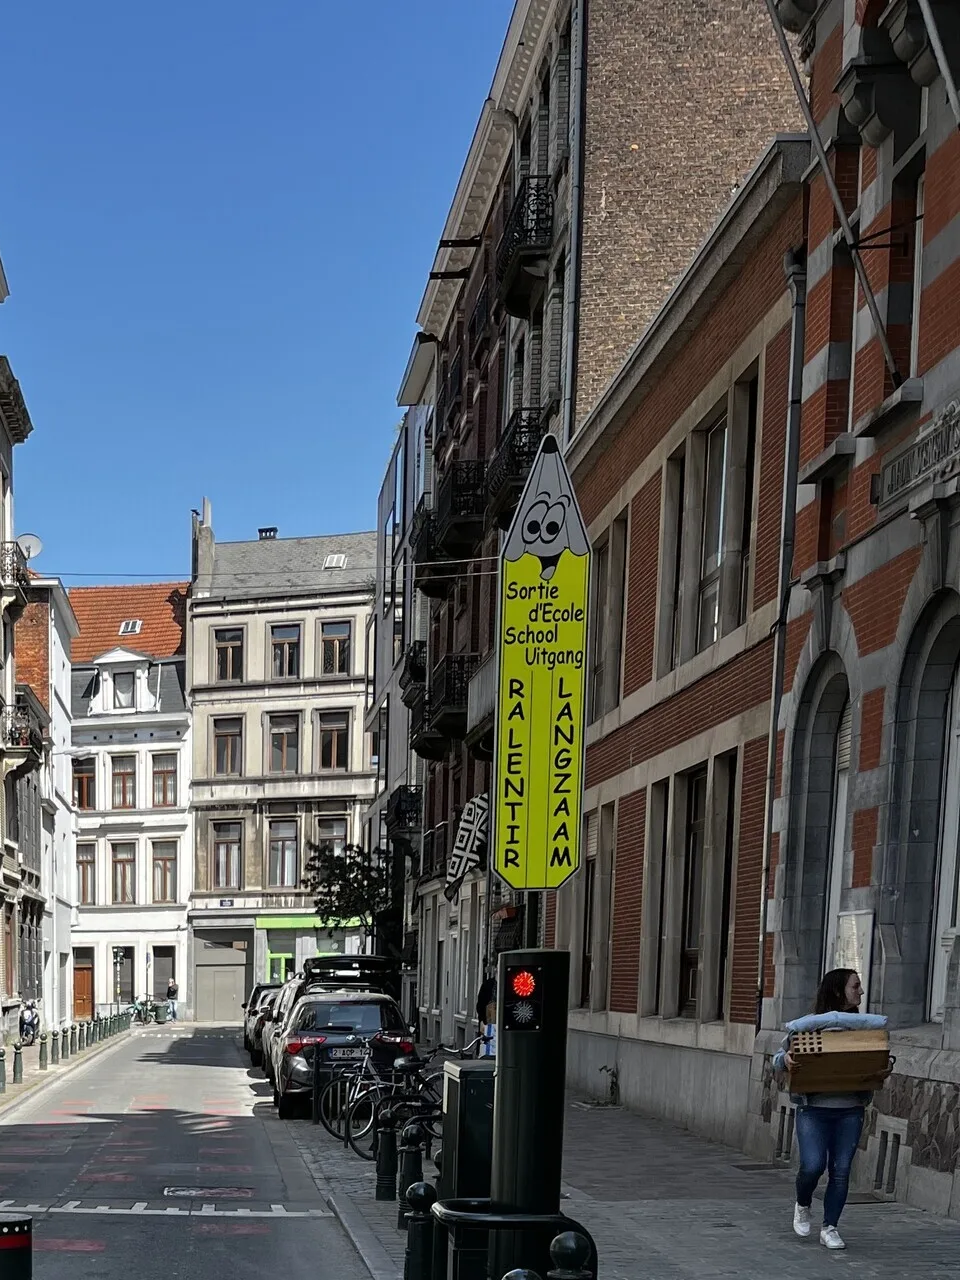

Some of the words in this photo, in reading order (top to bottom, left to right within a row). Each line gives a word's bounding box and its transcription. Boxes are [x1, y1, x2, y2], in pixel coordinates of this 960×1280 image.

[506, 580, 559, 600] Sortie
[528, 602, 584, 623] d'Ecole
[504, 624, 558, 645] School
[525, 647, 584, 670] Uitgang
[504, 678, 525, 868] RALENTIR
[549, 677, 575, 868] LANGZAAM
